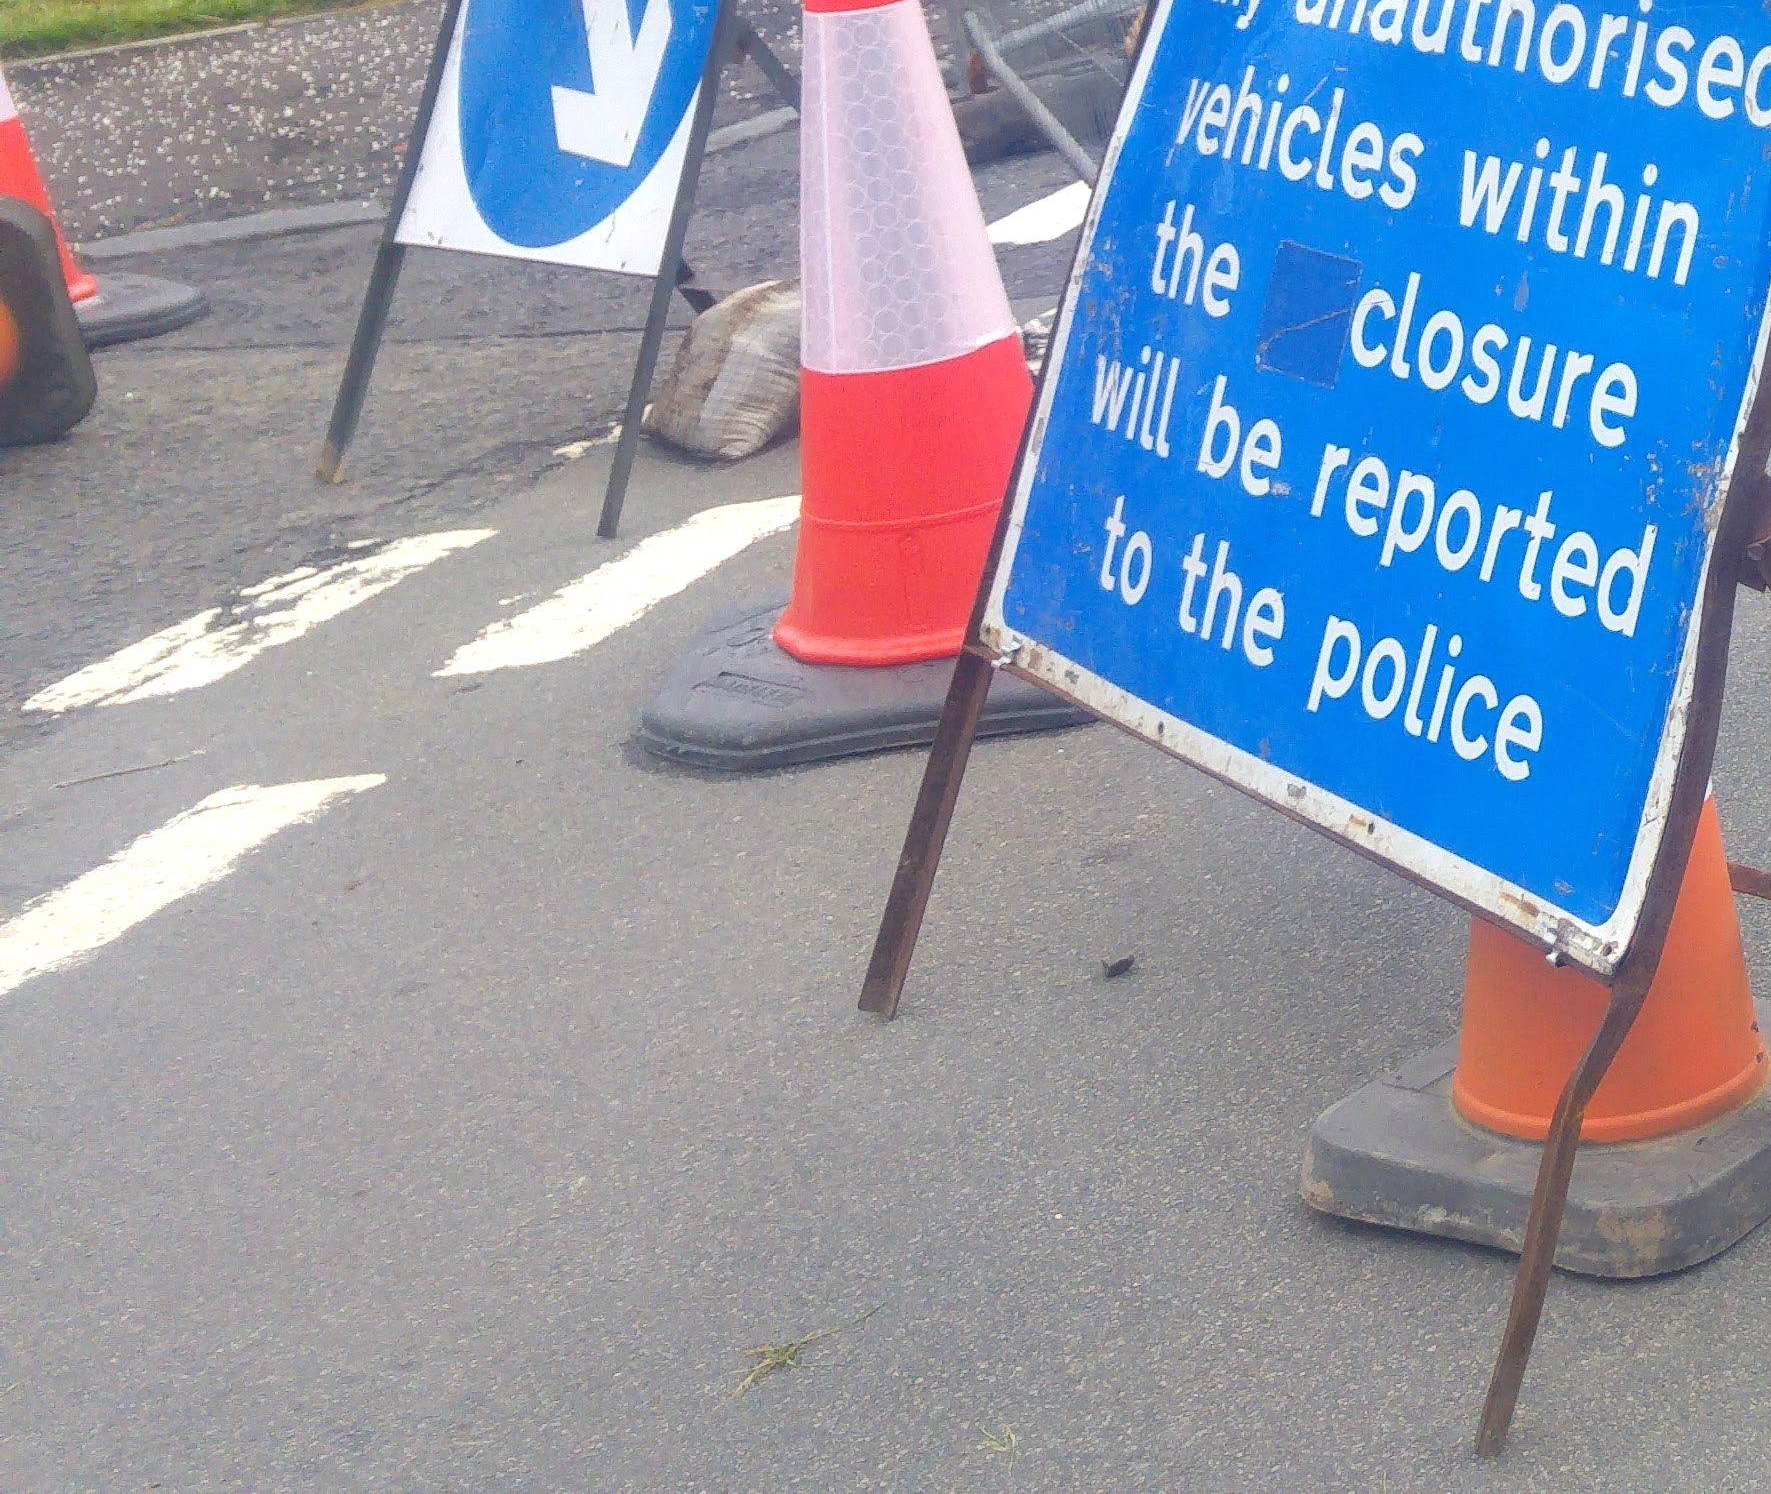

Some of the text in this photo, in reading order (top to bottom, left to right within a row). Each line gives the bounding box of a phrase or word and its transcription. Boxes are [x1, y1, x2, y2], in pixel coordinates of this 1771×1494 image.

[1176, 65, 1699, 286] vehicles within
[1152, 200, 1639, 448] the closure
[1092, 351, 1657, 638] will be reported
[1100, 495, 1544, 782] to the police
